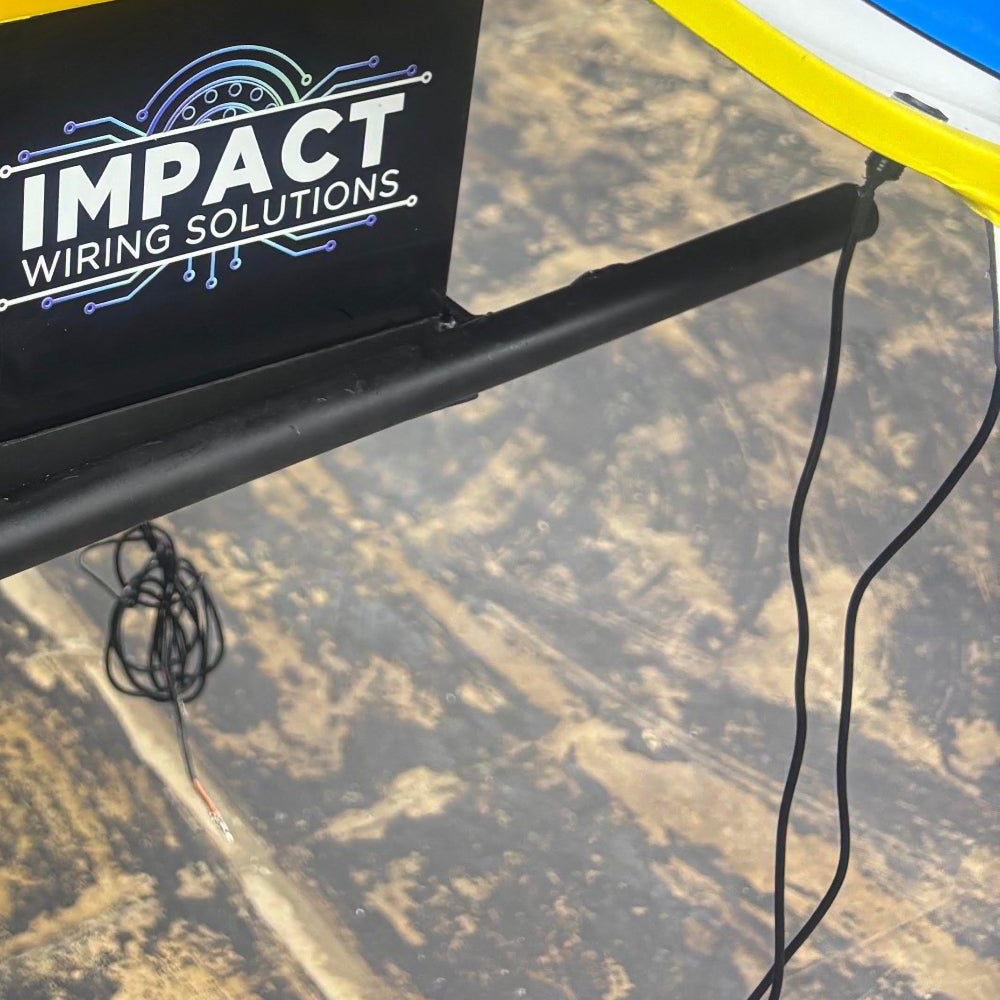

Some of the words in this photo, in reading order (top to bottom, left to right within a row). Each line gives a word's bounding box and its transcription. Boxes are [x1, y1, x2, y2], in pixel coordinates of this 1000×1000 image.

[21, 92, 406, 251] IMPACT
[21, 224, 171, 287] WIRING
[186, 168, 401, 244] SOLUTIONS
